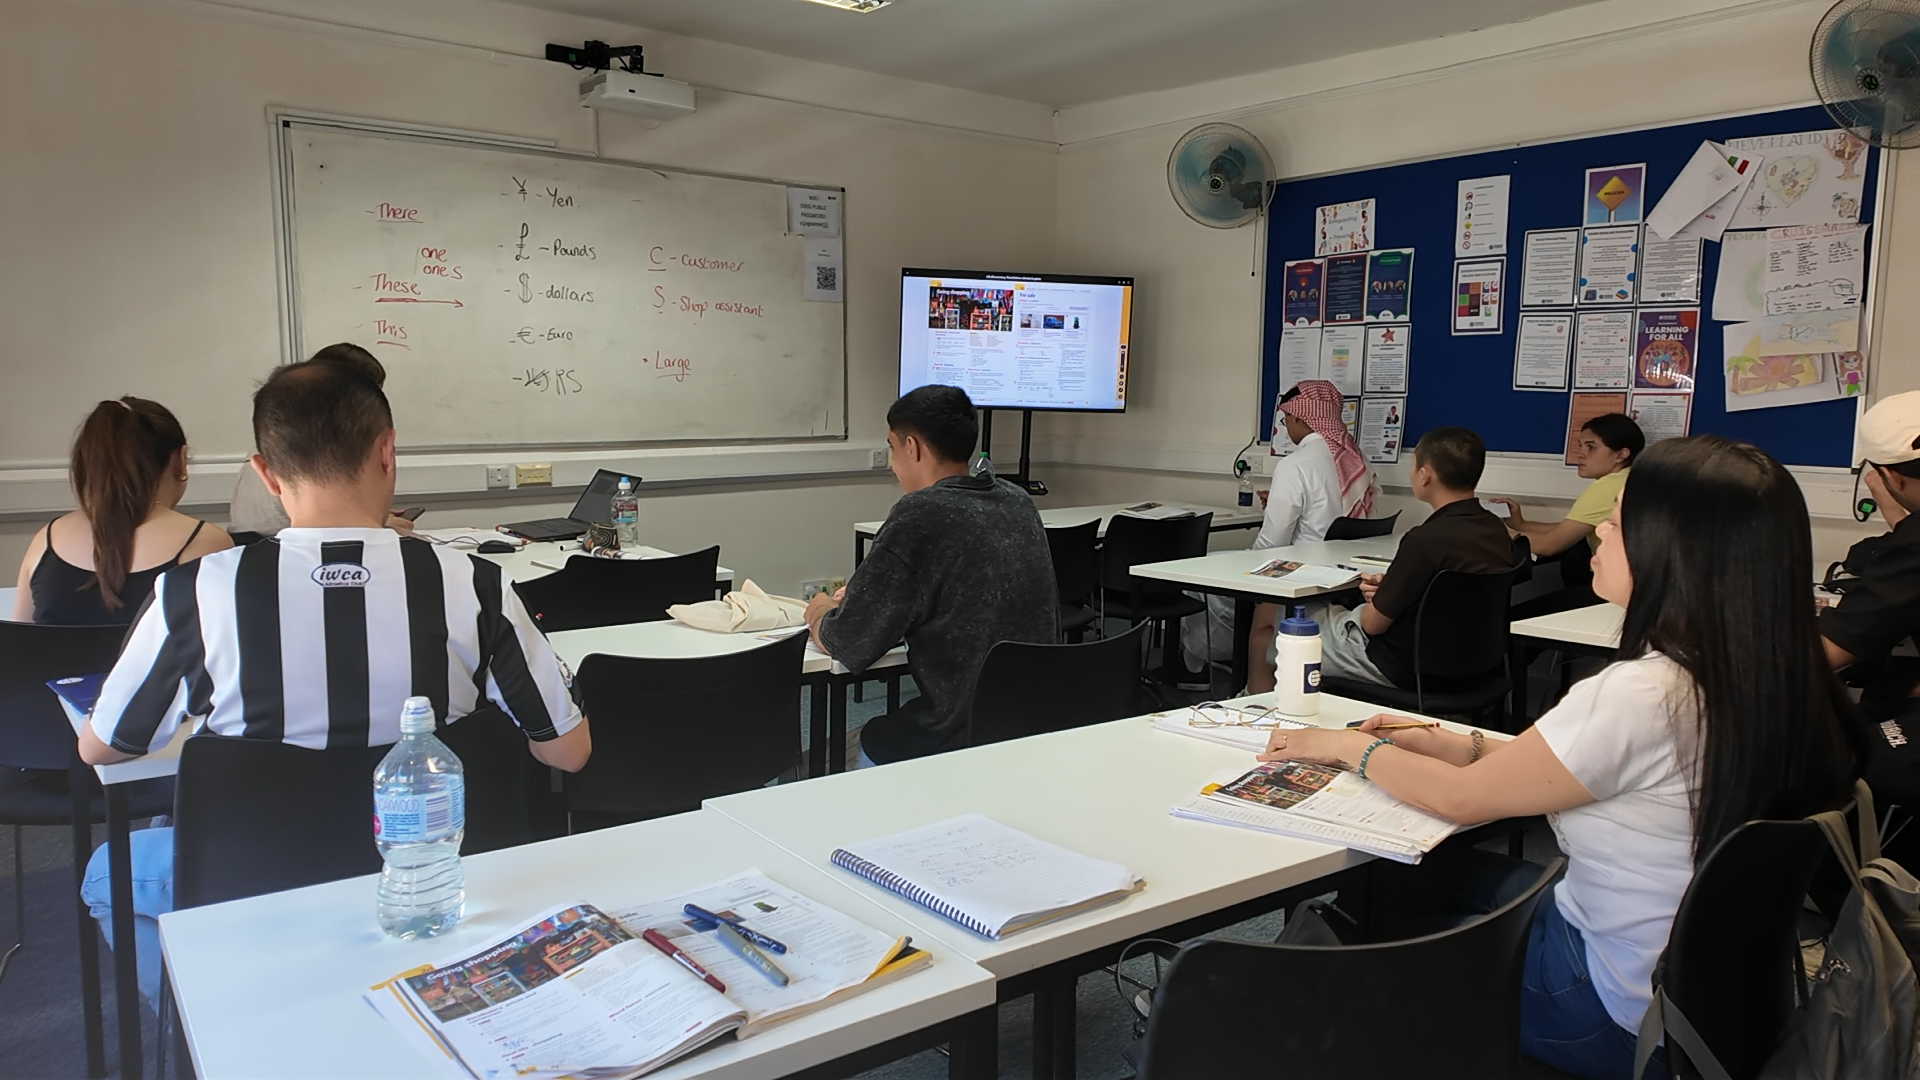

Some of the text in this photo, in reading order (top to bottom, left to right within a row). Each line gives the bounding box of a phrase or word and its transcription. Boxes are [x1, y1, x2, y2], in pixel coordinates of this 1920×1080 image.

[377, 202, 419, 221] There
[421, 247, 448, 262] one
[552, 239, 598, 261] Pounds
[650, 246, 664, 265] C
[370, 273, 422, 295] These
[518, 272, 595, 304] $ dollars
[653, 285, 765, 319] S Shop assistant
[373, 319, 409, 340] This
[1645, 325, 1690, 334] LEARNING
[1649, 333, 1684, 341] FOR ALL
[655, 350, 693, 383] Large
[319, 567, 363, 581] iwca
[426, 941, 518, 981] Going shopping
